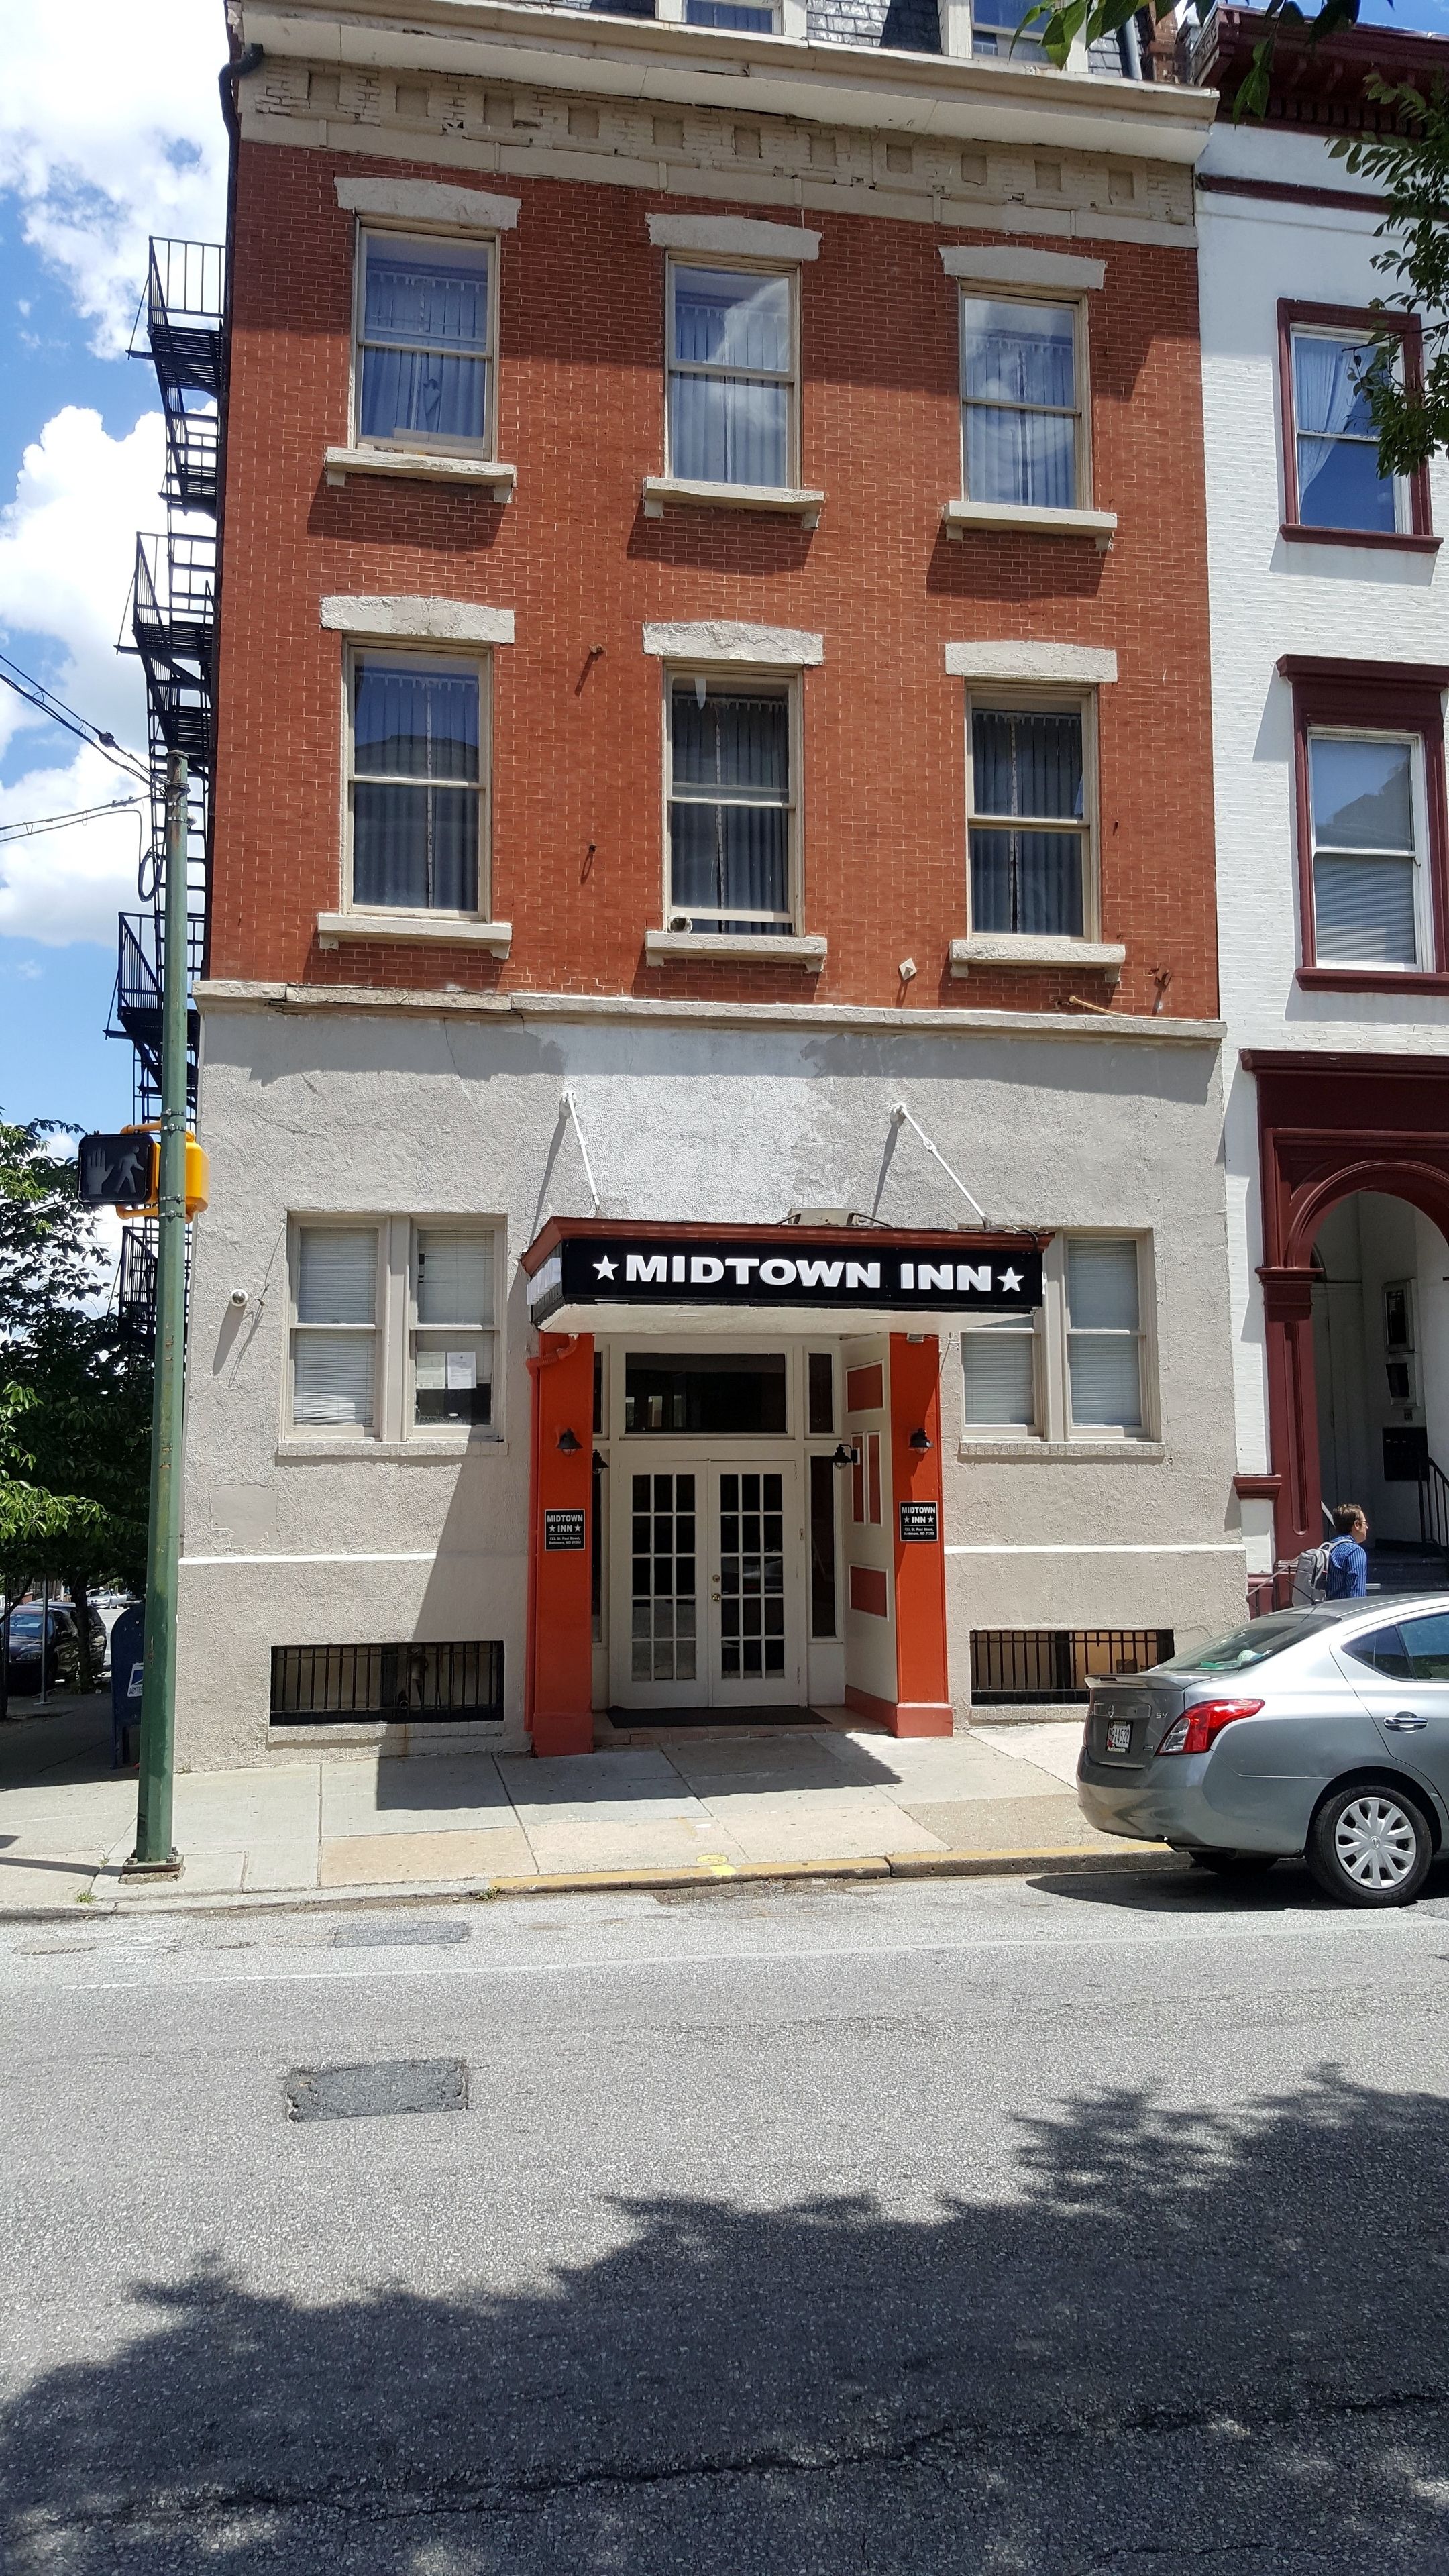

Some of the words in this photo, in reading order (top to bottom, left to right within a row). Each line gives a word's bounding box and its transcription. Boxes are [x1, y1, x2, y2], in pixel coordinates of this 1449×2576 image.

[625, 1254, 881, 1289] MIDTOWN
[900, 1263, 991, 1291] INN
[902, 1506, 936, 1514] MIDTOWN
[547, 1514, 583, 1523] MIDTOWN
